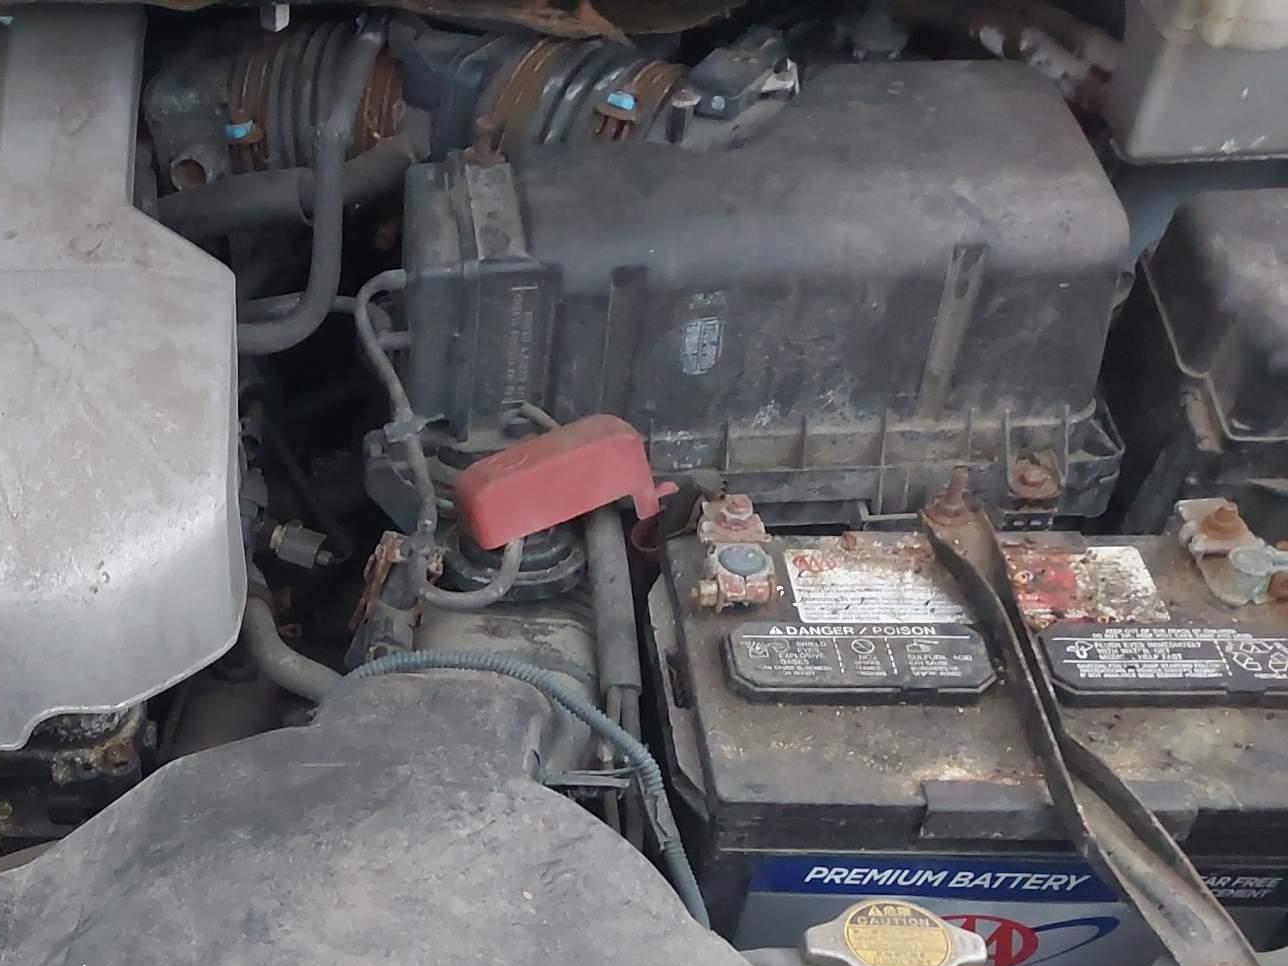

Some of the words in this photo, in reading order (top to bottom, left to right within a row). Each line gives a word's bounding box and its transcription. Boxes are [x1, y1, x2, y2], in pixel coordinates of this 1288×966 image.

[785, 626, 856, 635] DANGER
[873, 626, 937, 636] POISON
[804, 866, 949, 888] PREMIUM
[948, 871, 1090, 892] BATTERY
[1231, 876, 1284, 888] FREE
[857, 915, 930, 928] CAUTION
